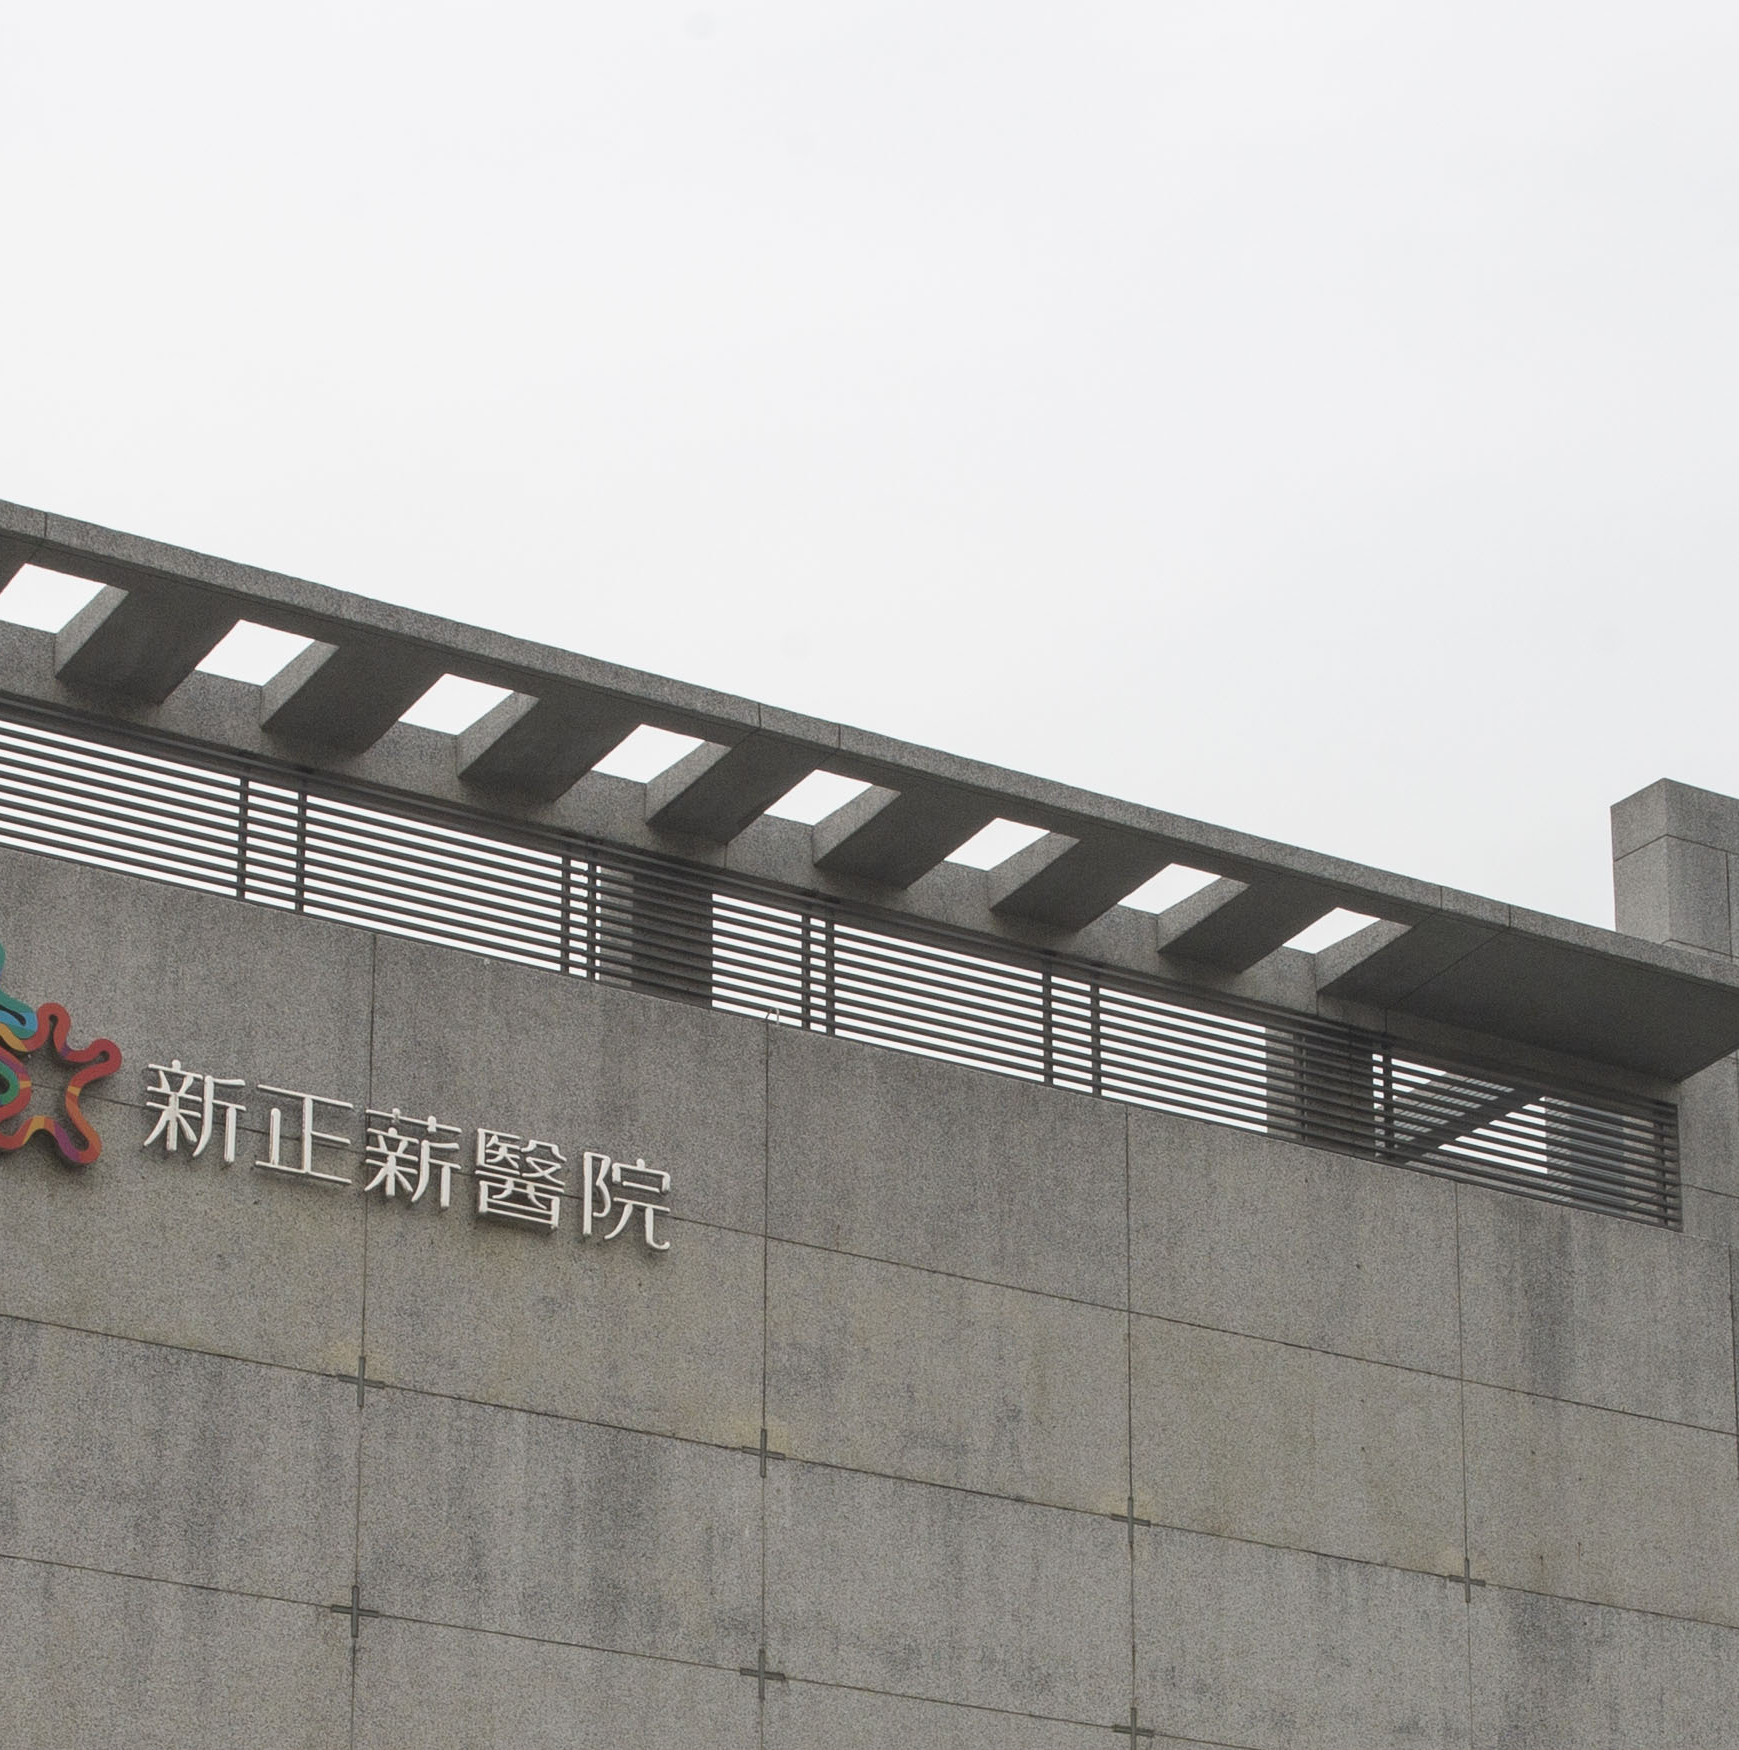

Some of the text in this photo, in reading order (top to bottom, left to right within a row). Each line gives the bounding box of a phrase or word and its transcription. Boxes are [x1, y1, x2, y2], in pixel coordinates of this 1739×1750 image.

[143, 1059, 671, 1251] 新正薪醫院
